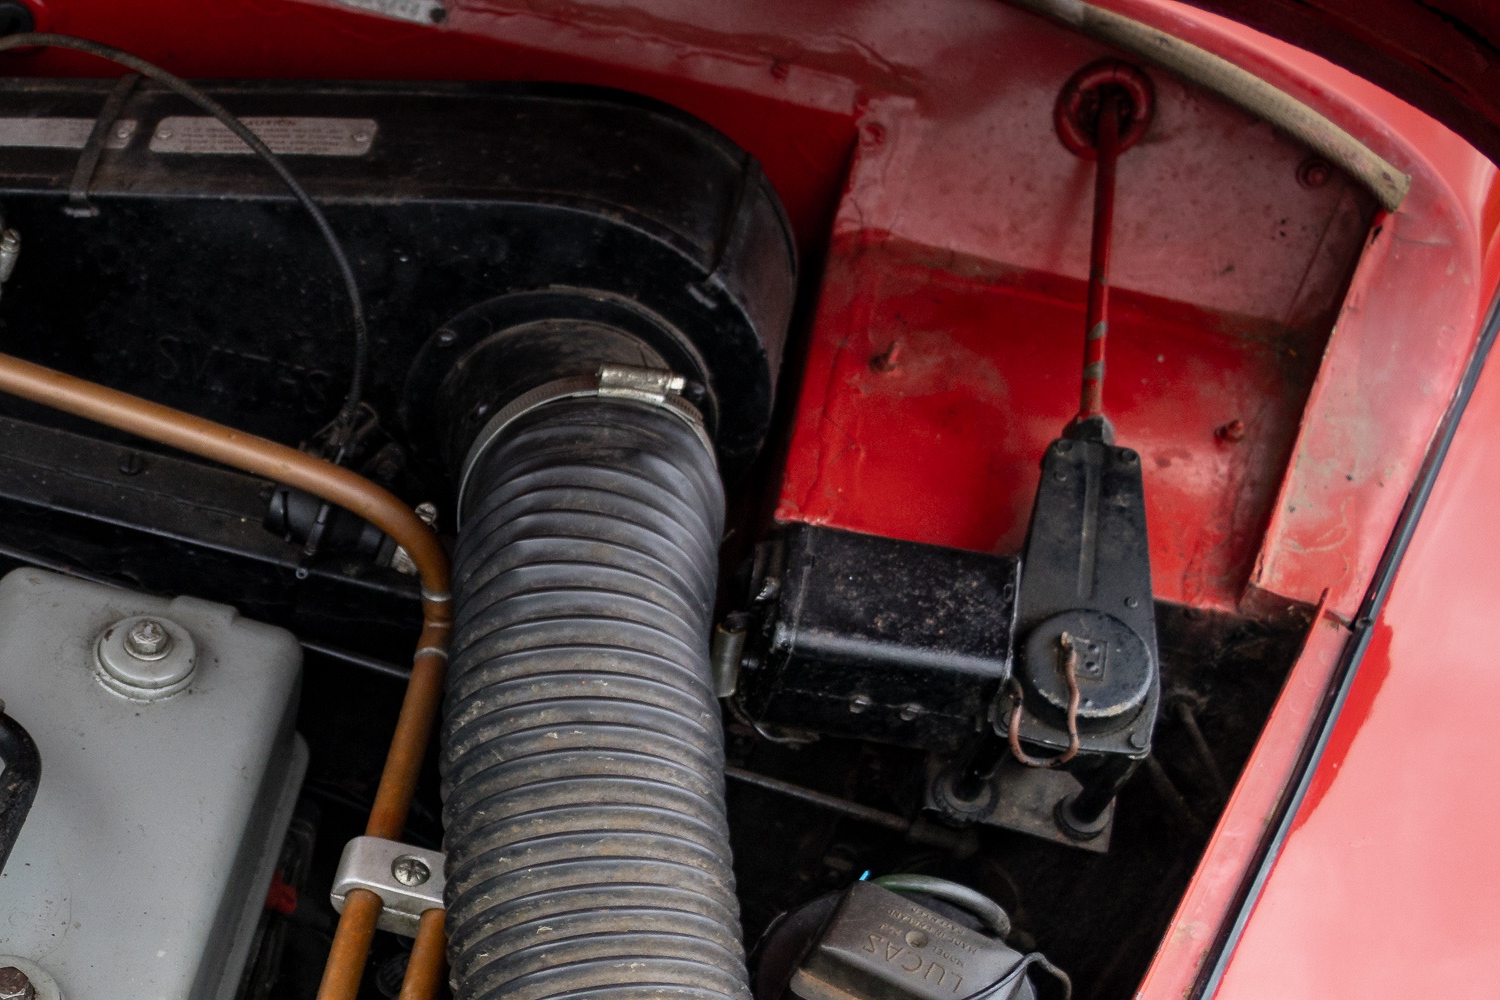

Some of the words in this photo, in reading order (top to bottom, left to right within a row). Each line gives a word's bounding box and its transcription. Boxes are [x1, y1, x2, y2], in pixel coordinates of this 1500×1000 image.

[885, 906, 932, 934] ENGLAND
[933, 928, 945, 939] IN
[931, 945, 965, 967] MODEL
[946, 935, 977, 955] MADE
[863, 933, 964, 994] LUCAS
